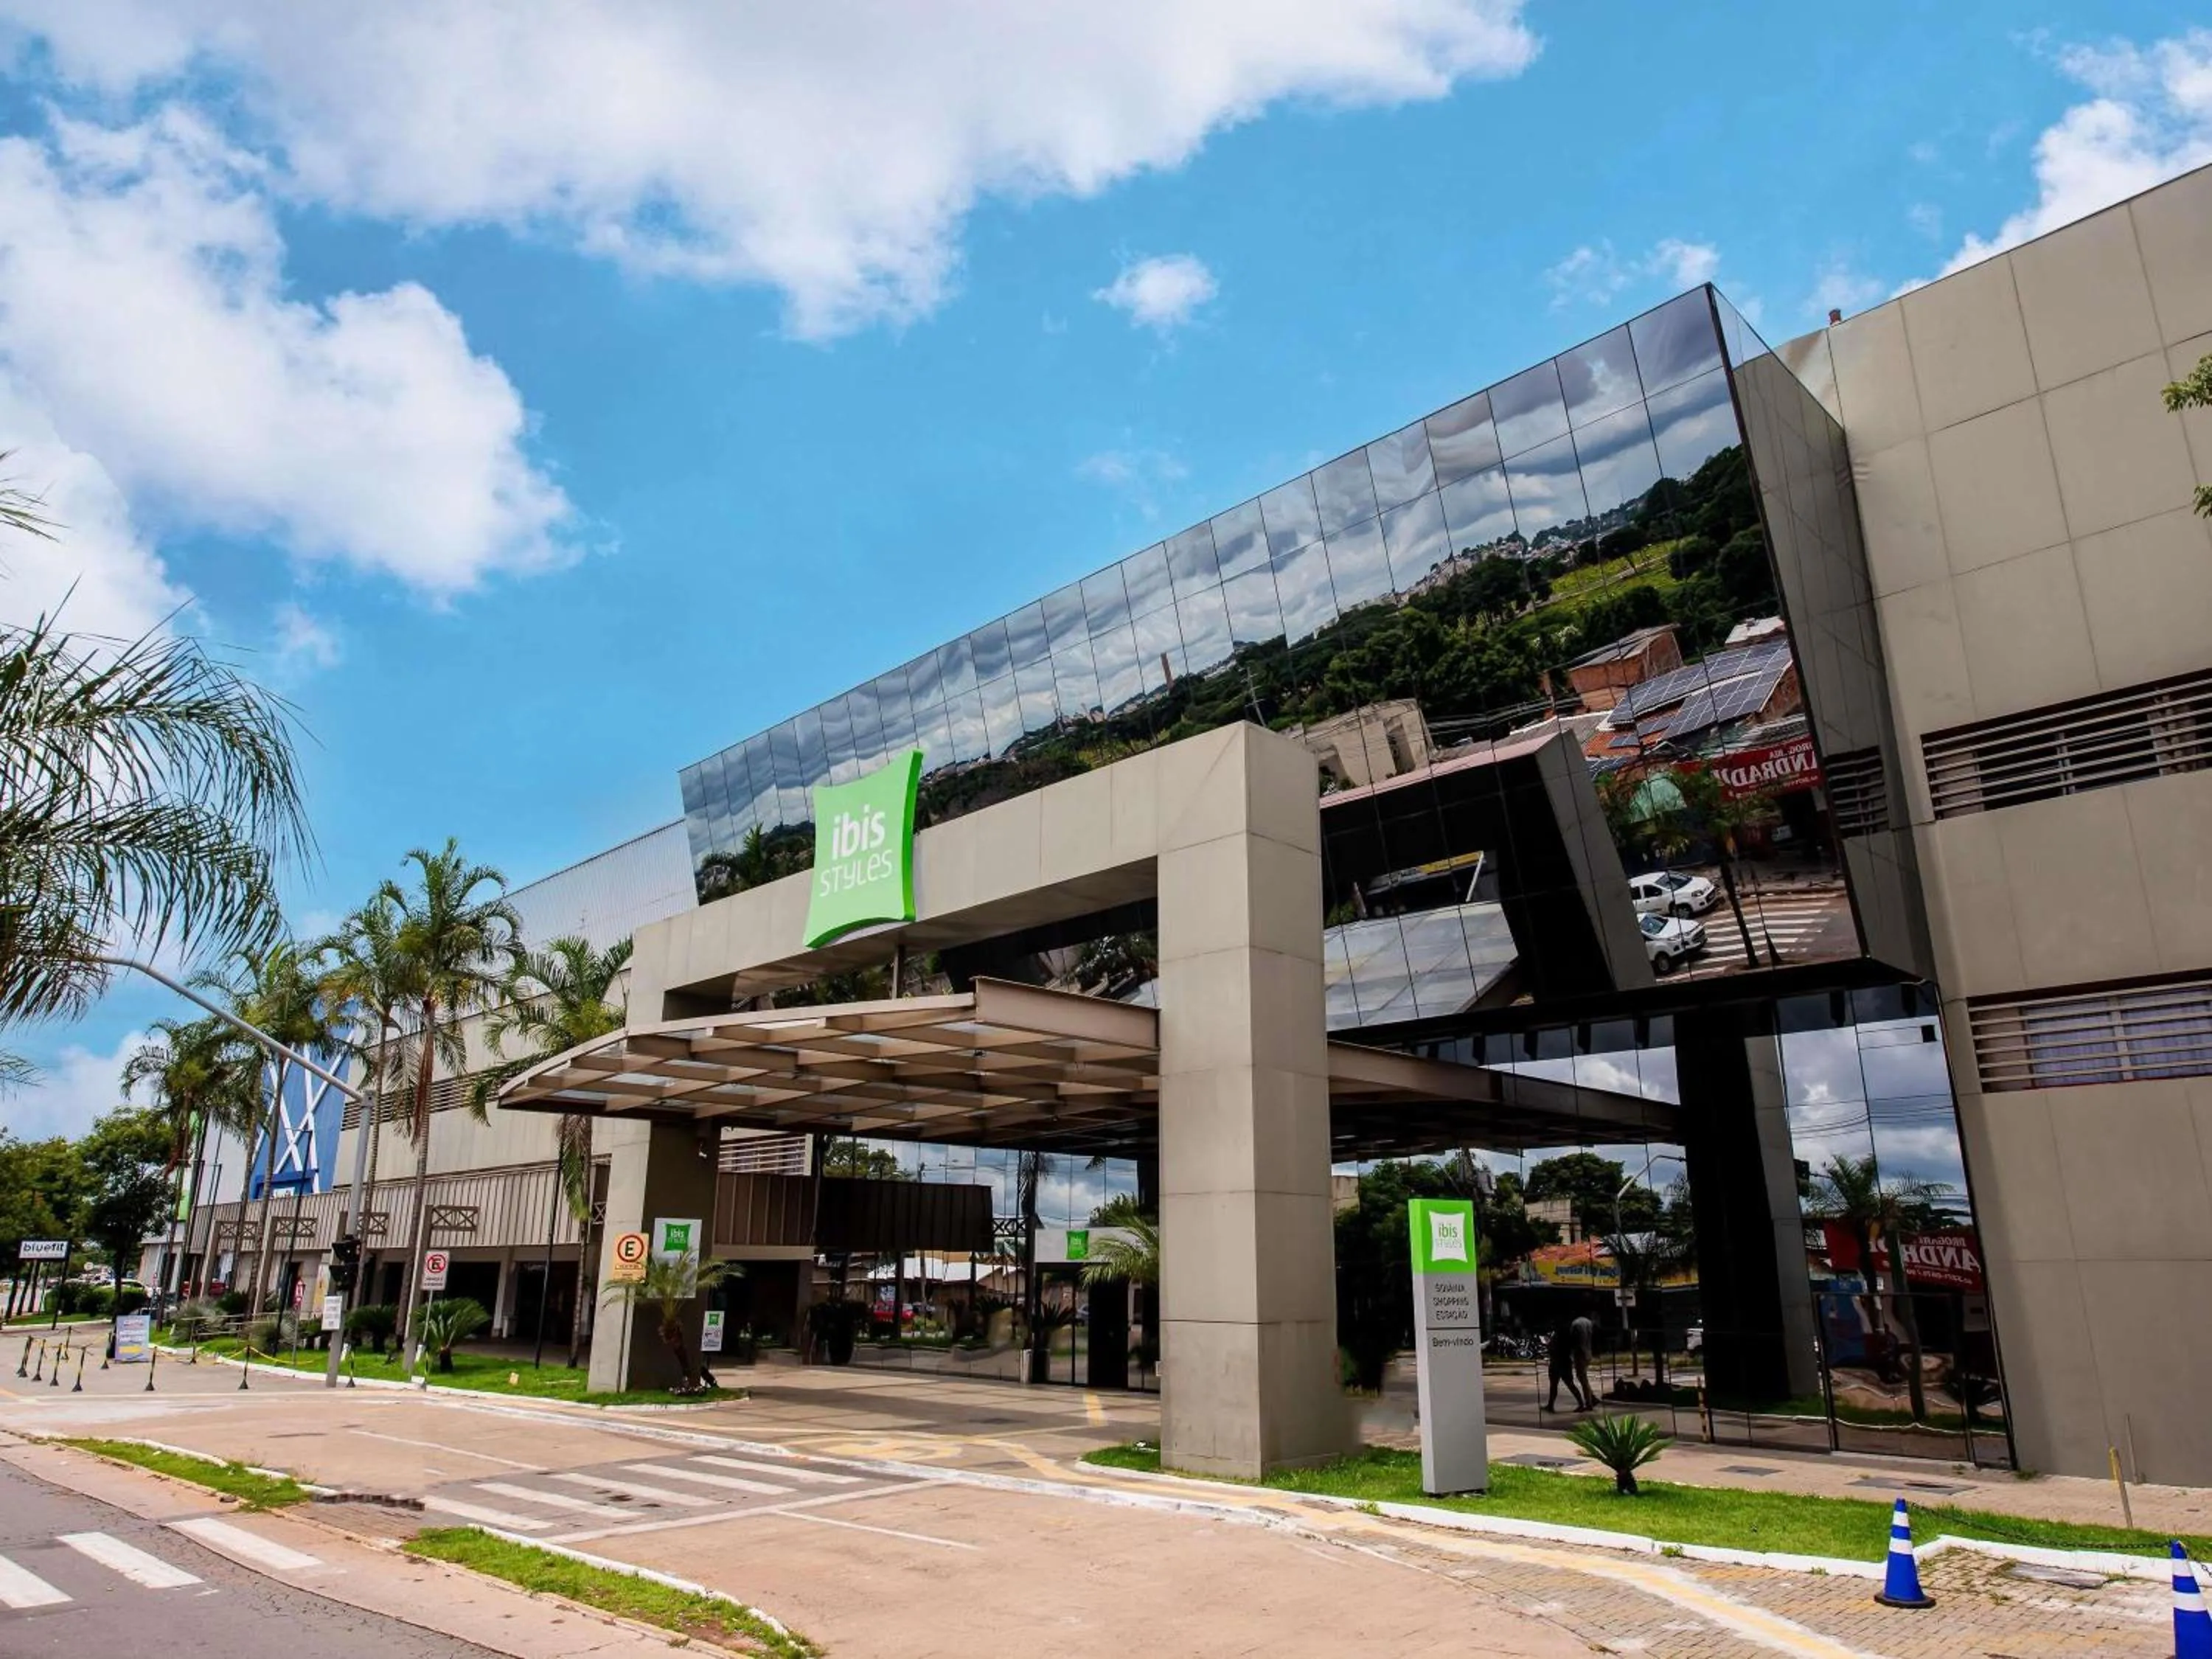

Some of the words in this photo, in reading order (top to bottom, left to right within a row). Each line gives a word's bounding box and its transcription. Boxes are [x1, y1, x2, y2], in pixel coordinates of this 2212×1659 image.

[831, 804, 886, 861] ibis
[1439, 1222, 1458, 1238] ibis
[24, 1242, 64, 1252] bluefit
[625, 1241, 635, 1256] E
